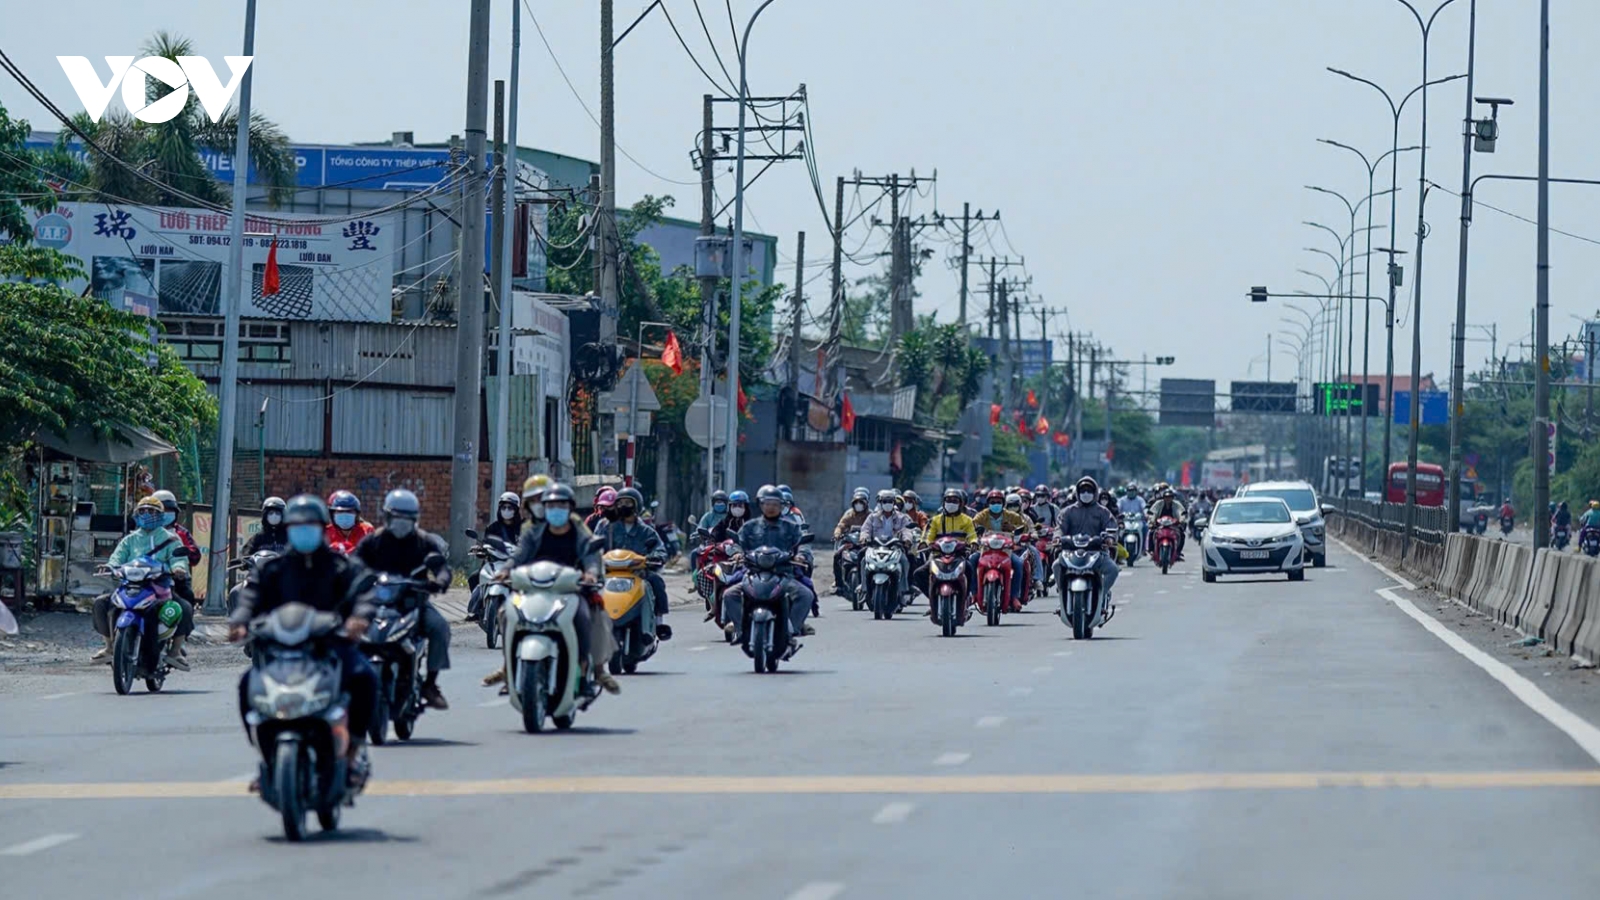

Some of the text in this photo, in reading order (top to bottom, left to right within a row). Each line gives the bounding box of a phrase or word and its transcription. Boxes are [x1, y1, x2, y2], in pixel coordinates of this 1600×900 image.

[330, 155, 354, 166] TỔNG
[355, 156, 380, 167] CÔNG
[382, 158, 393, 167] TY
[395, 157, 417, 168] THÉP
[94, 210, 136, 240] 瑞
[160, 210, 190, 229] LƯỚI
[196, 213, 228, 231] THÉP
[38, 227, 68, 239] V.T.P
